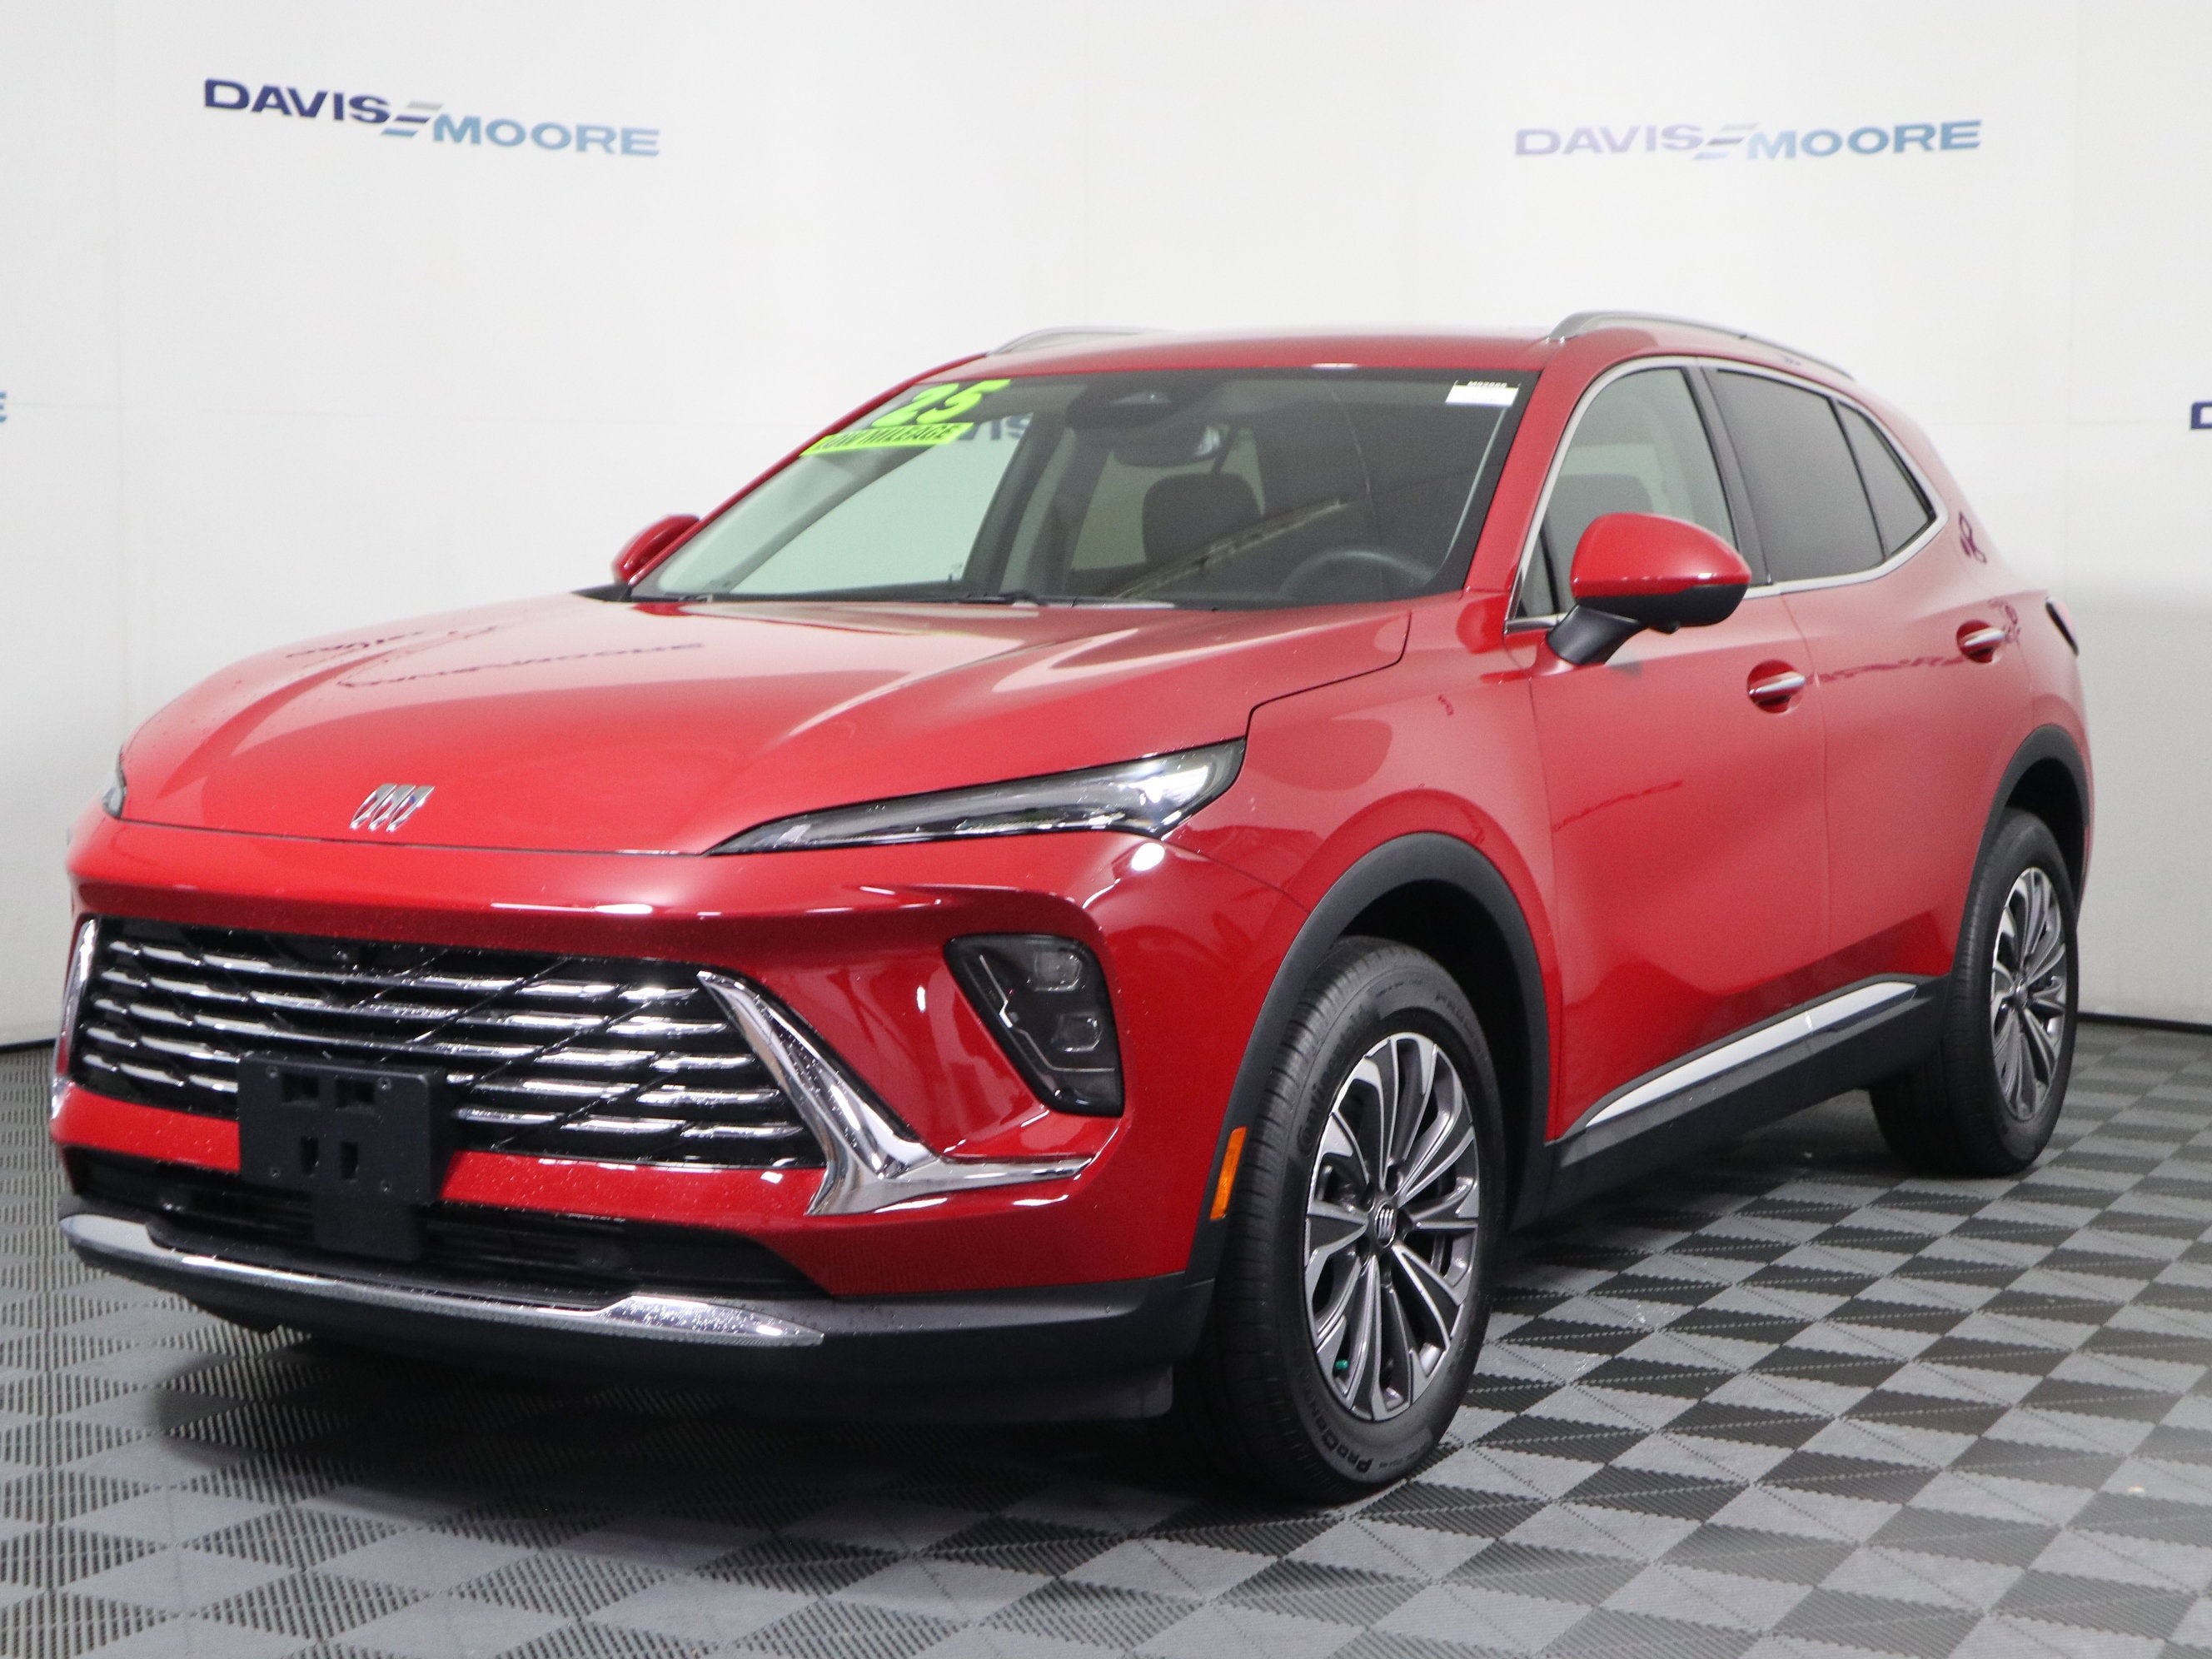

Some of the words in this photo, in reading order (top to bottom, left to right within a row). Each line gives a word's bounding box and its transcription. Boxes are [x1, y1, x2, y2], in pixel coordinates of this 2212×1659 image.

[204, 77, 390, 123] DAVIS
[432, 112, 661, 157] MOORE
[1514, 123, 1706, 157] DAVIS
[1746, 119, 1983, 160] MOORE
[870, 378, 1012, 427] 25
[857, 424, 956, 445] MILEAGE
